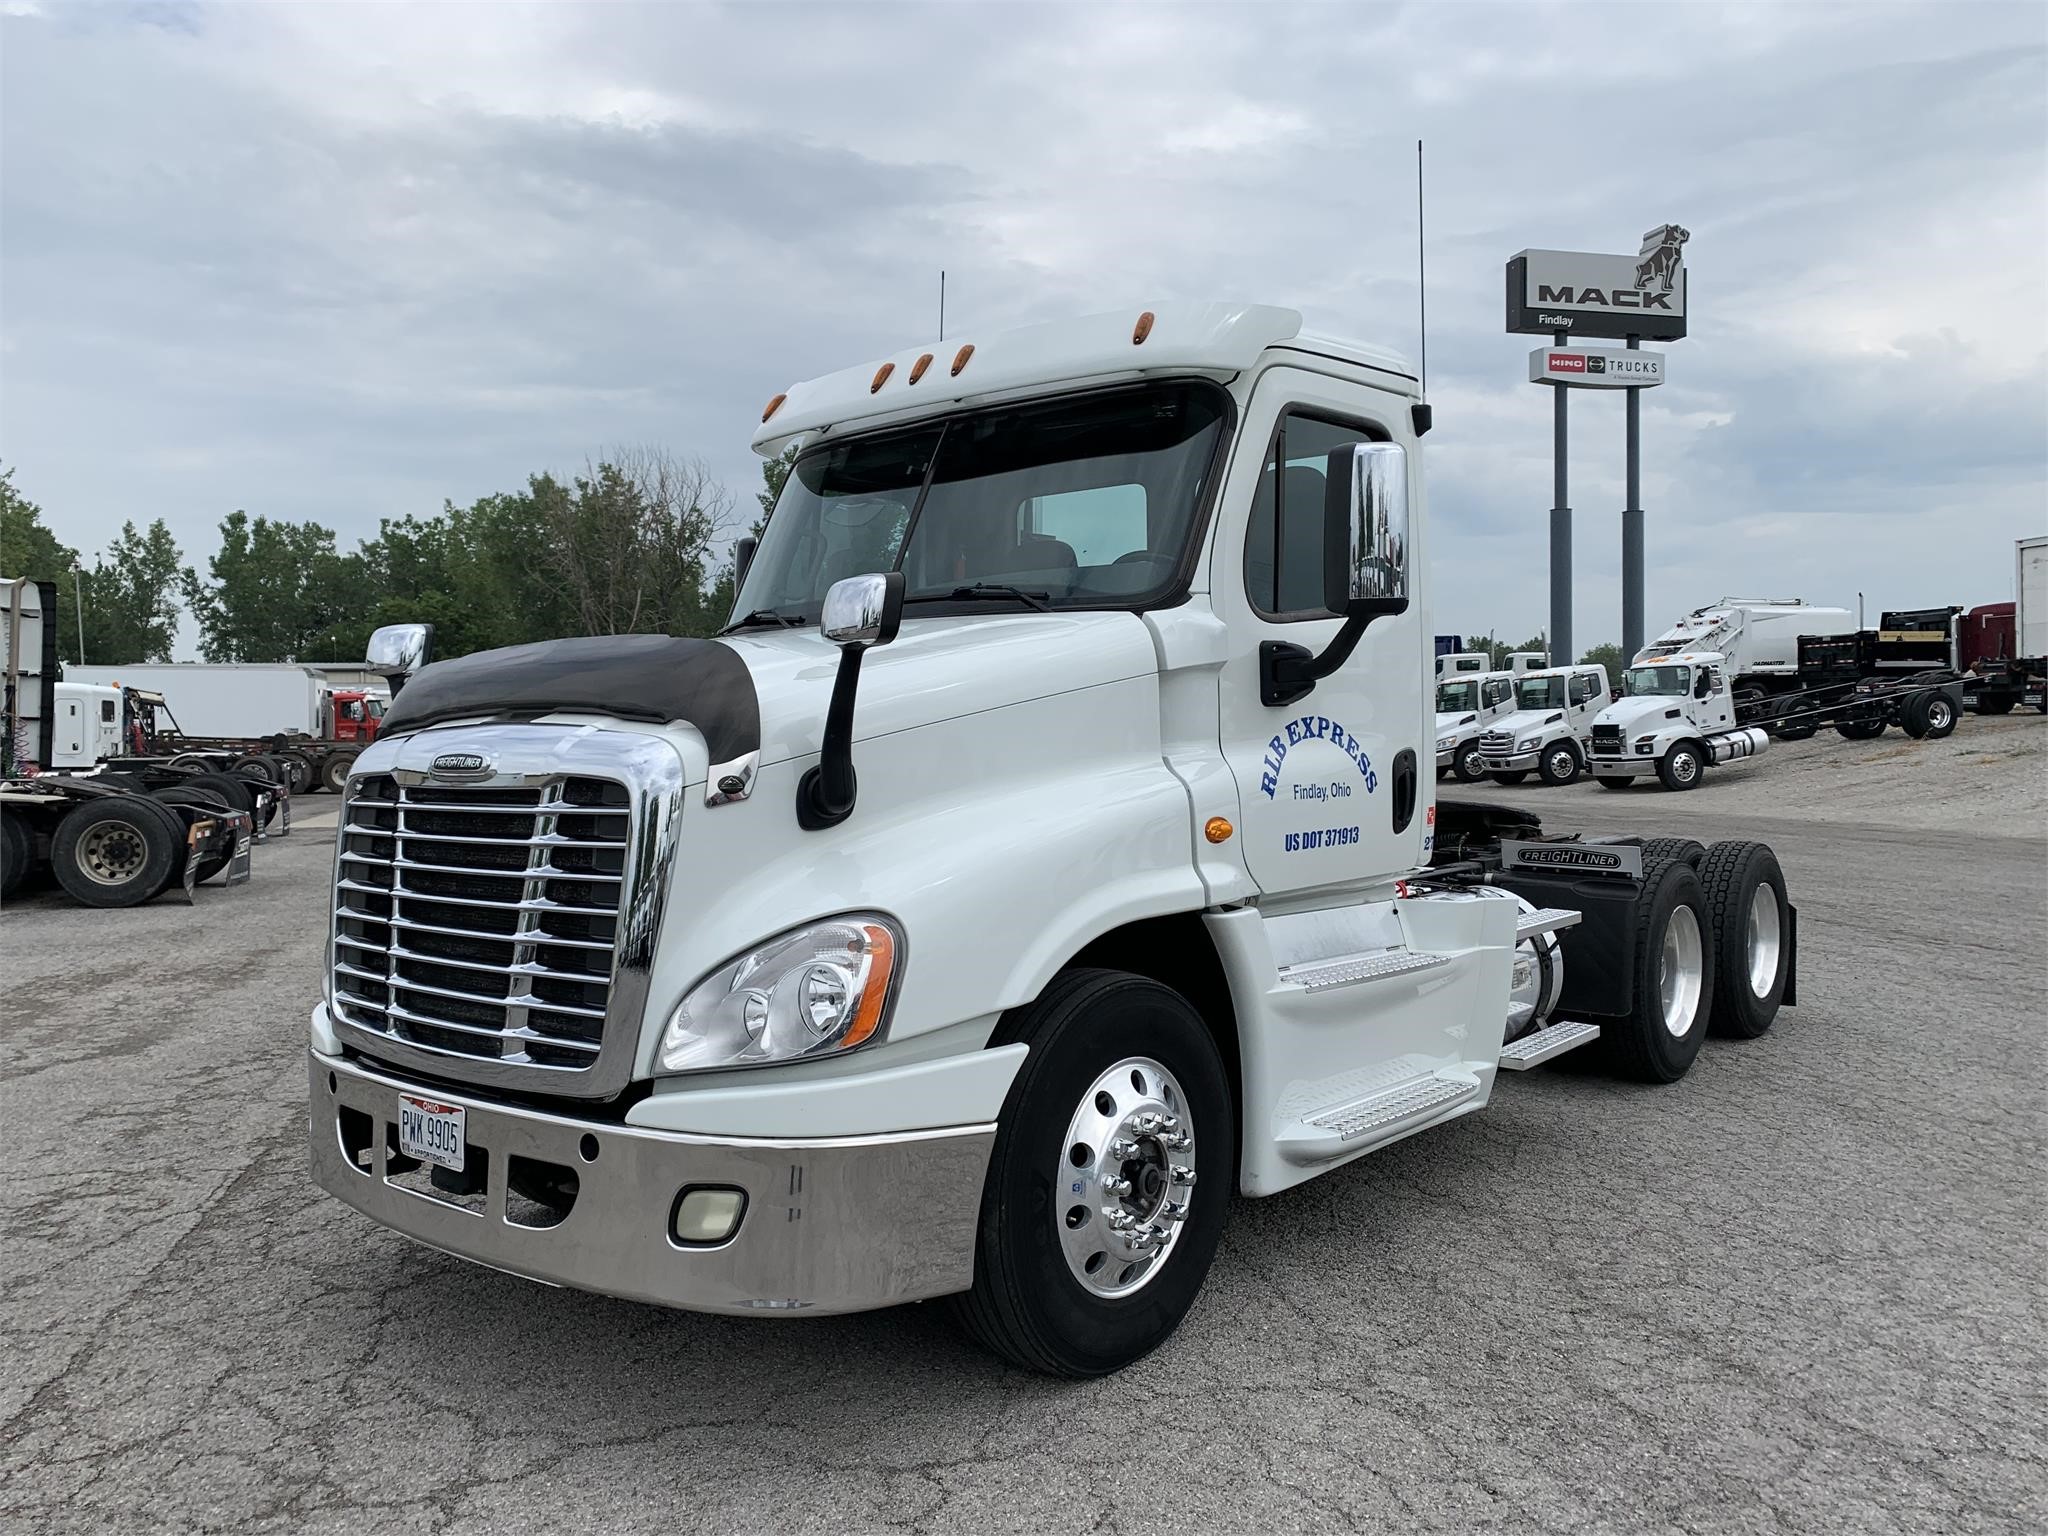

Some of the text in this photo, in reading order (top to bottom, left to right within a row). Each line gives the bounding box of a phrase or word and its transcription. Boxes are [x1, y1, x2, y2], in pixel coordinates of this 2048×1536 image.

[1538, 285, 1672, 310] MACK
[1539, 314, 1574, 327] Findlay
[1551, 359, 1658, 373] HINO TRUCKS
[435, 756, 482, 768] FREIGHTLINER
[1260, 715, 1378, 800] RLB EXPRESS
[1293, 782, 1351, 802] Findlay, Ohio
[1285, 826, 1359, 852] US DOT 371913
[1524, 851, 1615, 865] FREIGHTLINER
[422, 1101, 440, 1113] OHIO
[402, 1110, 458, 1154] PWK 9905
